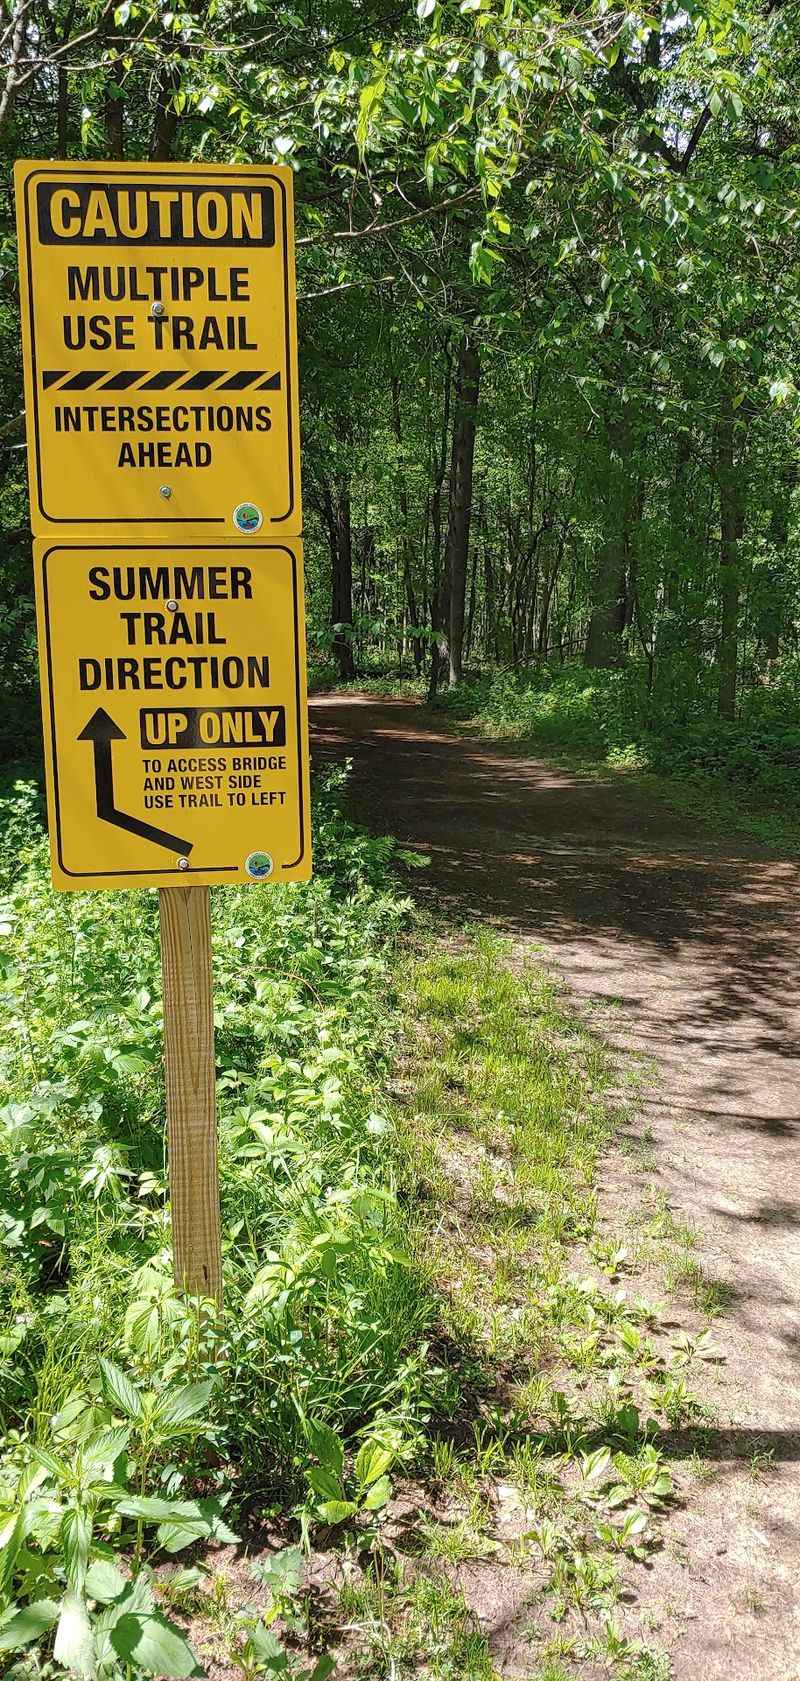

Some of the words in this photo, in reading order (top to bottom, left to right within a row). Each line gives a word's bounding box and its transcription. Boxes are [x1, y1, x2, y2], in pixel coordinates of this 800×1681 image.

[50, 188, 263, 239] CAUTION
[67, 266, 250, 302] MULTIPLE
[63, 315, 136, 351] USE
[147, 315, 258, 351] TRAIL
[54, 406, 272, 433] INTERSECTIONS
[117, 442, 212, 468] AHEAD
[88, 566, 253, 601] SUMMER
[120, 612, 227, 646] TRAIL
[78, 656, 270, 691] DIRECTION
[144, 712, 188, 745] UP
[199, 711, 280, 744] ONLY
[142, 759, 162, 773] TO
[167, 757, 227, 773] ACCESS
[232, 756, 287, 771] BRIDGE
[143, 777, 175, 791] AND
[180, 776, 224, 791] WEST
[228, 775, 262, 789] SIDE
[144, 795, 174, 809] USE
[178, 794, 223, 808] TRAIL
[227, 793, 246, 807] TO
[251, 791, 287, 806] LEFT
